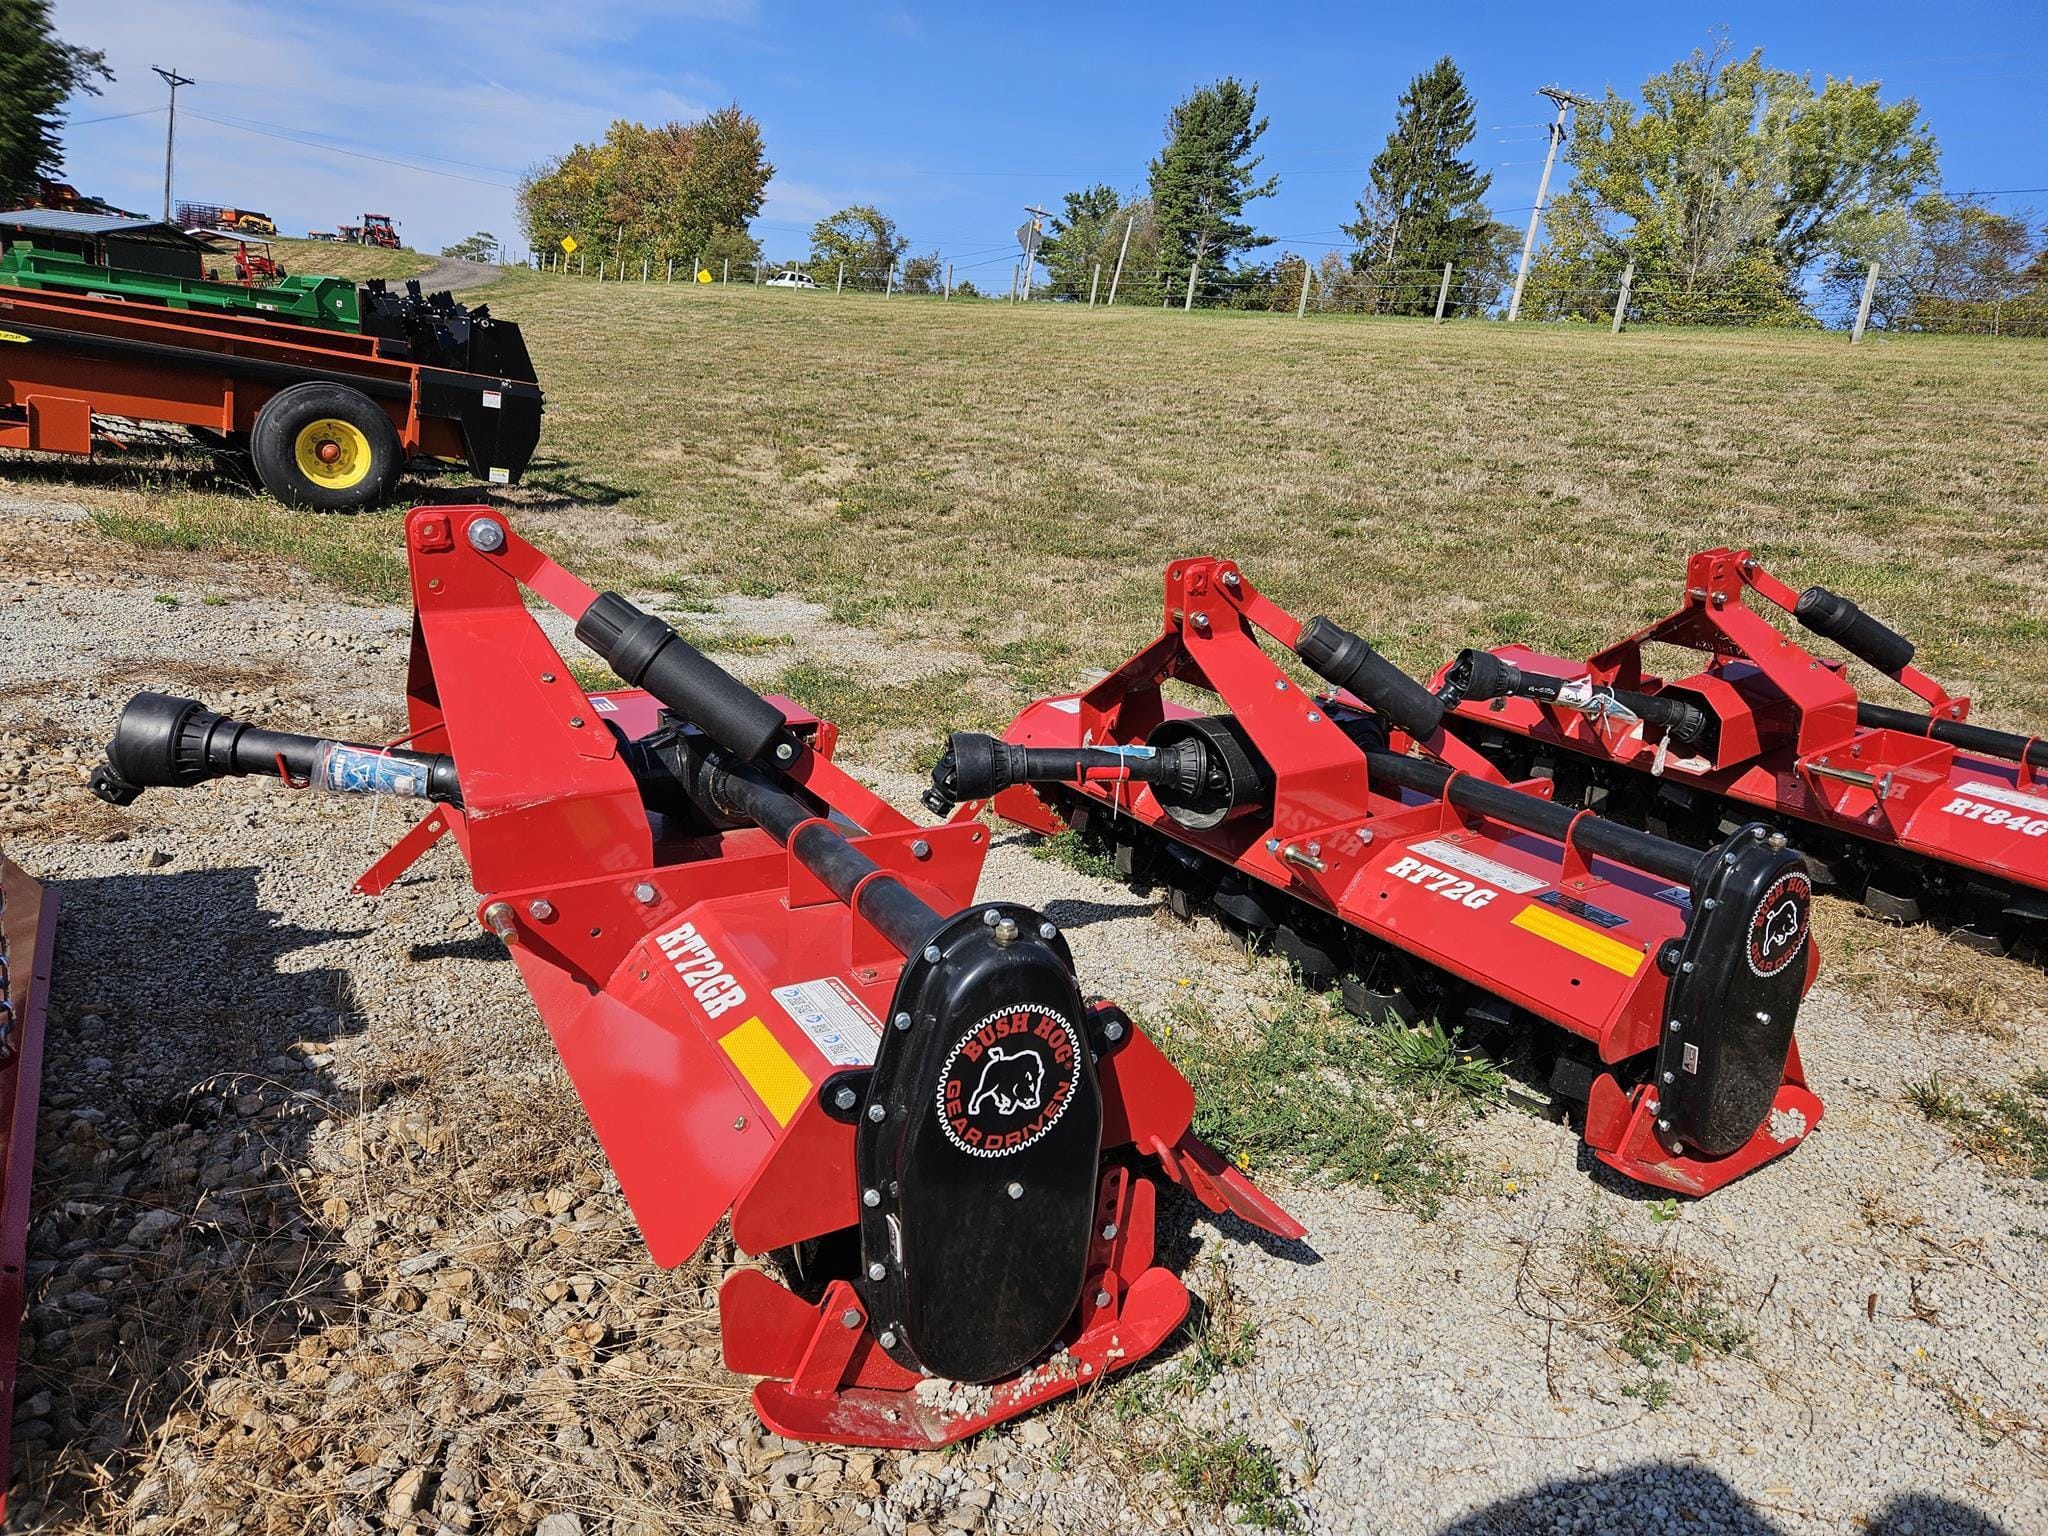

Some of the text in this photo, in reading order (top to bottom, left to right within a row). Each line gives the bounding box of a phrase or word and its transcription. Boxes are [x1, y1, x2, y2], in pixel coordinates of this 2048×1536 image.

[1941, 797, 2048, 837] RT84G
[1384, 856, 1499, 910] RT72G
[1755, 878, 1809, 928] BUSH HOG
[655, 921, 747, 1020] RT72GR
[961, 1013, 1073, 1064] BUSH HOG
[946, 1080, 1070, 1149] GEAR DRIVEN
